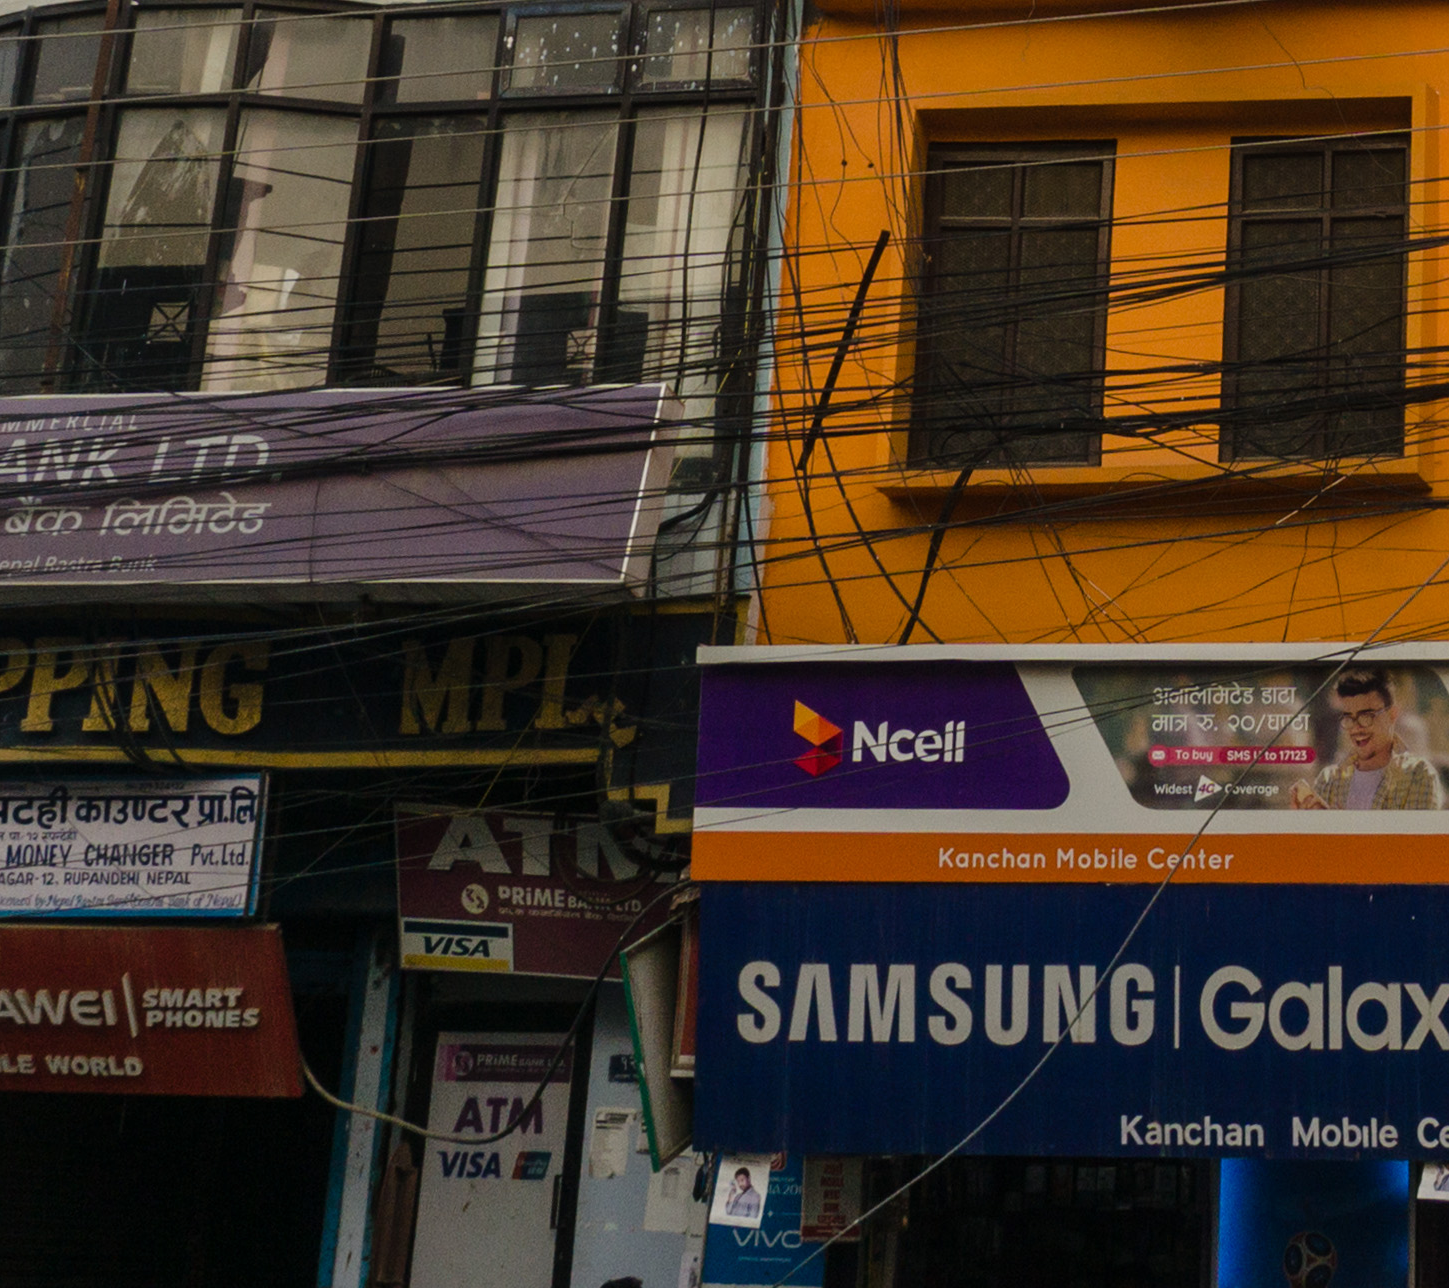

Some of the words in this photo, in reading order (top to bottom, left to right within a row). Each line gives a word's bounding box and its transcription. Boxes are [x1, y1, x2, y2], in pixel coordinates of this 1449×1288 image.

[99, 491, 272, 536] लिमिटेड
[1260, 685, 1297, 705] डाटा
[1151, 713, 1188, 732] मात्र
[852, 720, 966, 764] Ncell
[1175, 749, 1190, 761] To
[1191, 749, 1214, 763] buy
[1226, 749, 1251, 762] SMS
[1264, 750, 1278, 762] to
[1279, 749, 1308, 762] 17123
[1153, 783, 1193, 796] Widest
[1224, 782, 1279, 797] Coverage
[75, 794, 194, 828] काउण्टर
[6, 844, 72, 868] MONEY
[84, 844, 174, 867] CHANGER
[938, 847, 1047, 870] Kanchan
[1056, 847, 1138, 870] Mobile
[1146, 847, 1235, 870] Center
[63, 871, 140, 886] RUPANDEHI
[146, 871, 191, 885] NEPAL
[422, 935, 491, 958] VISA
[142, 987, 244, 1009] SMART
[736, 960, 1157, 1048] SAMSUNG
[145, 1007, 260, 1029] PHONES
[45, 1053, 144, 1077] WORLD
[453, 1096, 544, 1134] ATM
[1120, 1115, 1265, 1149] Kanchan
[1291, 1115, 1399, 1149] Mobile
[437, 1151, 501, 1177] VISA
